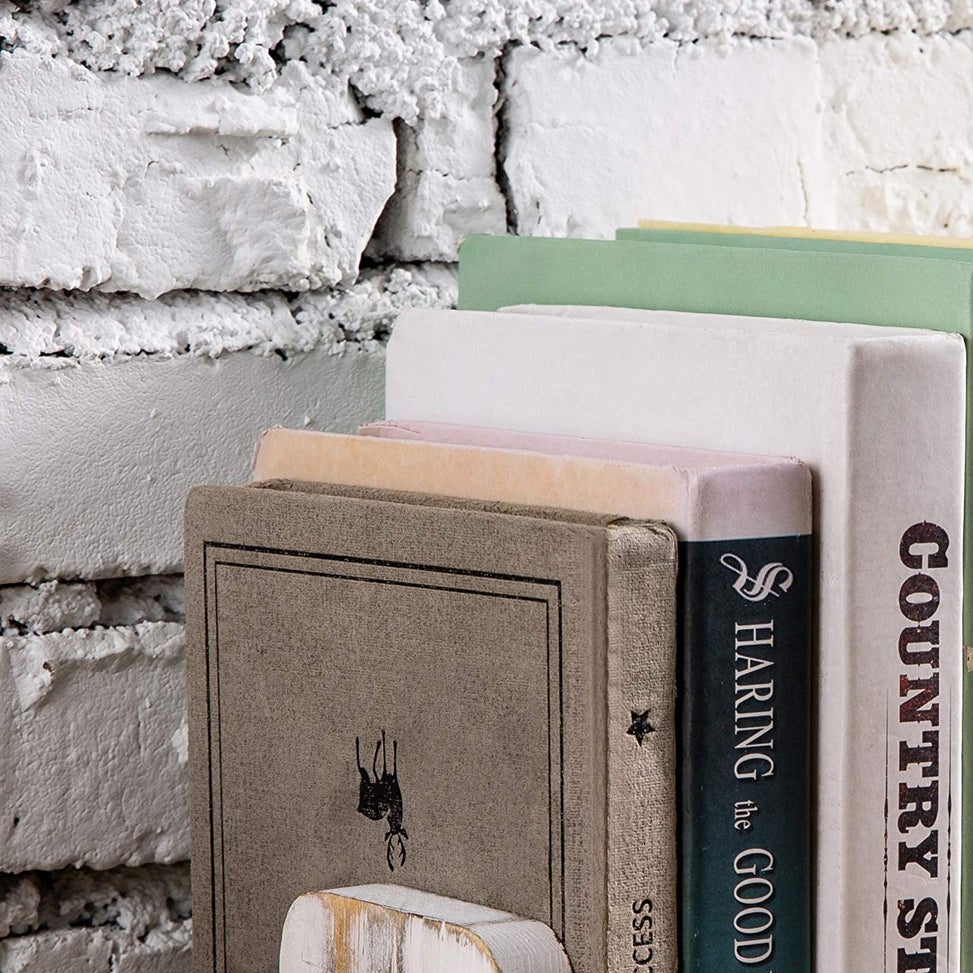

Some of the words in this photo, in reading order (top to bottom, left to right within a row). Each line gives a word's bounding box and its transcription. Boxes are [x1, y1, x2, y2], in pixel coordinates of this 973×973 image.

[719, 553, 794, 781] SHARING
[897, 520, 951, 879] COUNTRY
[734, 799, 758, 830] the
[733, 848, 774, 964] GOOD
